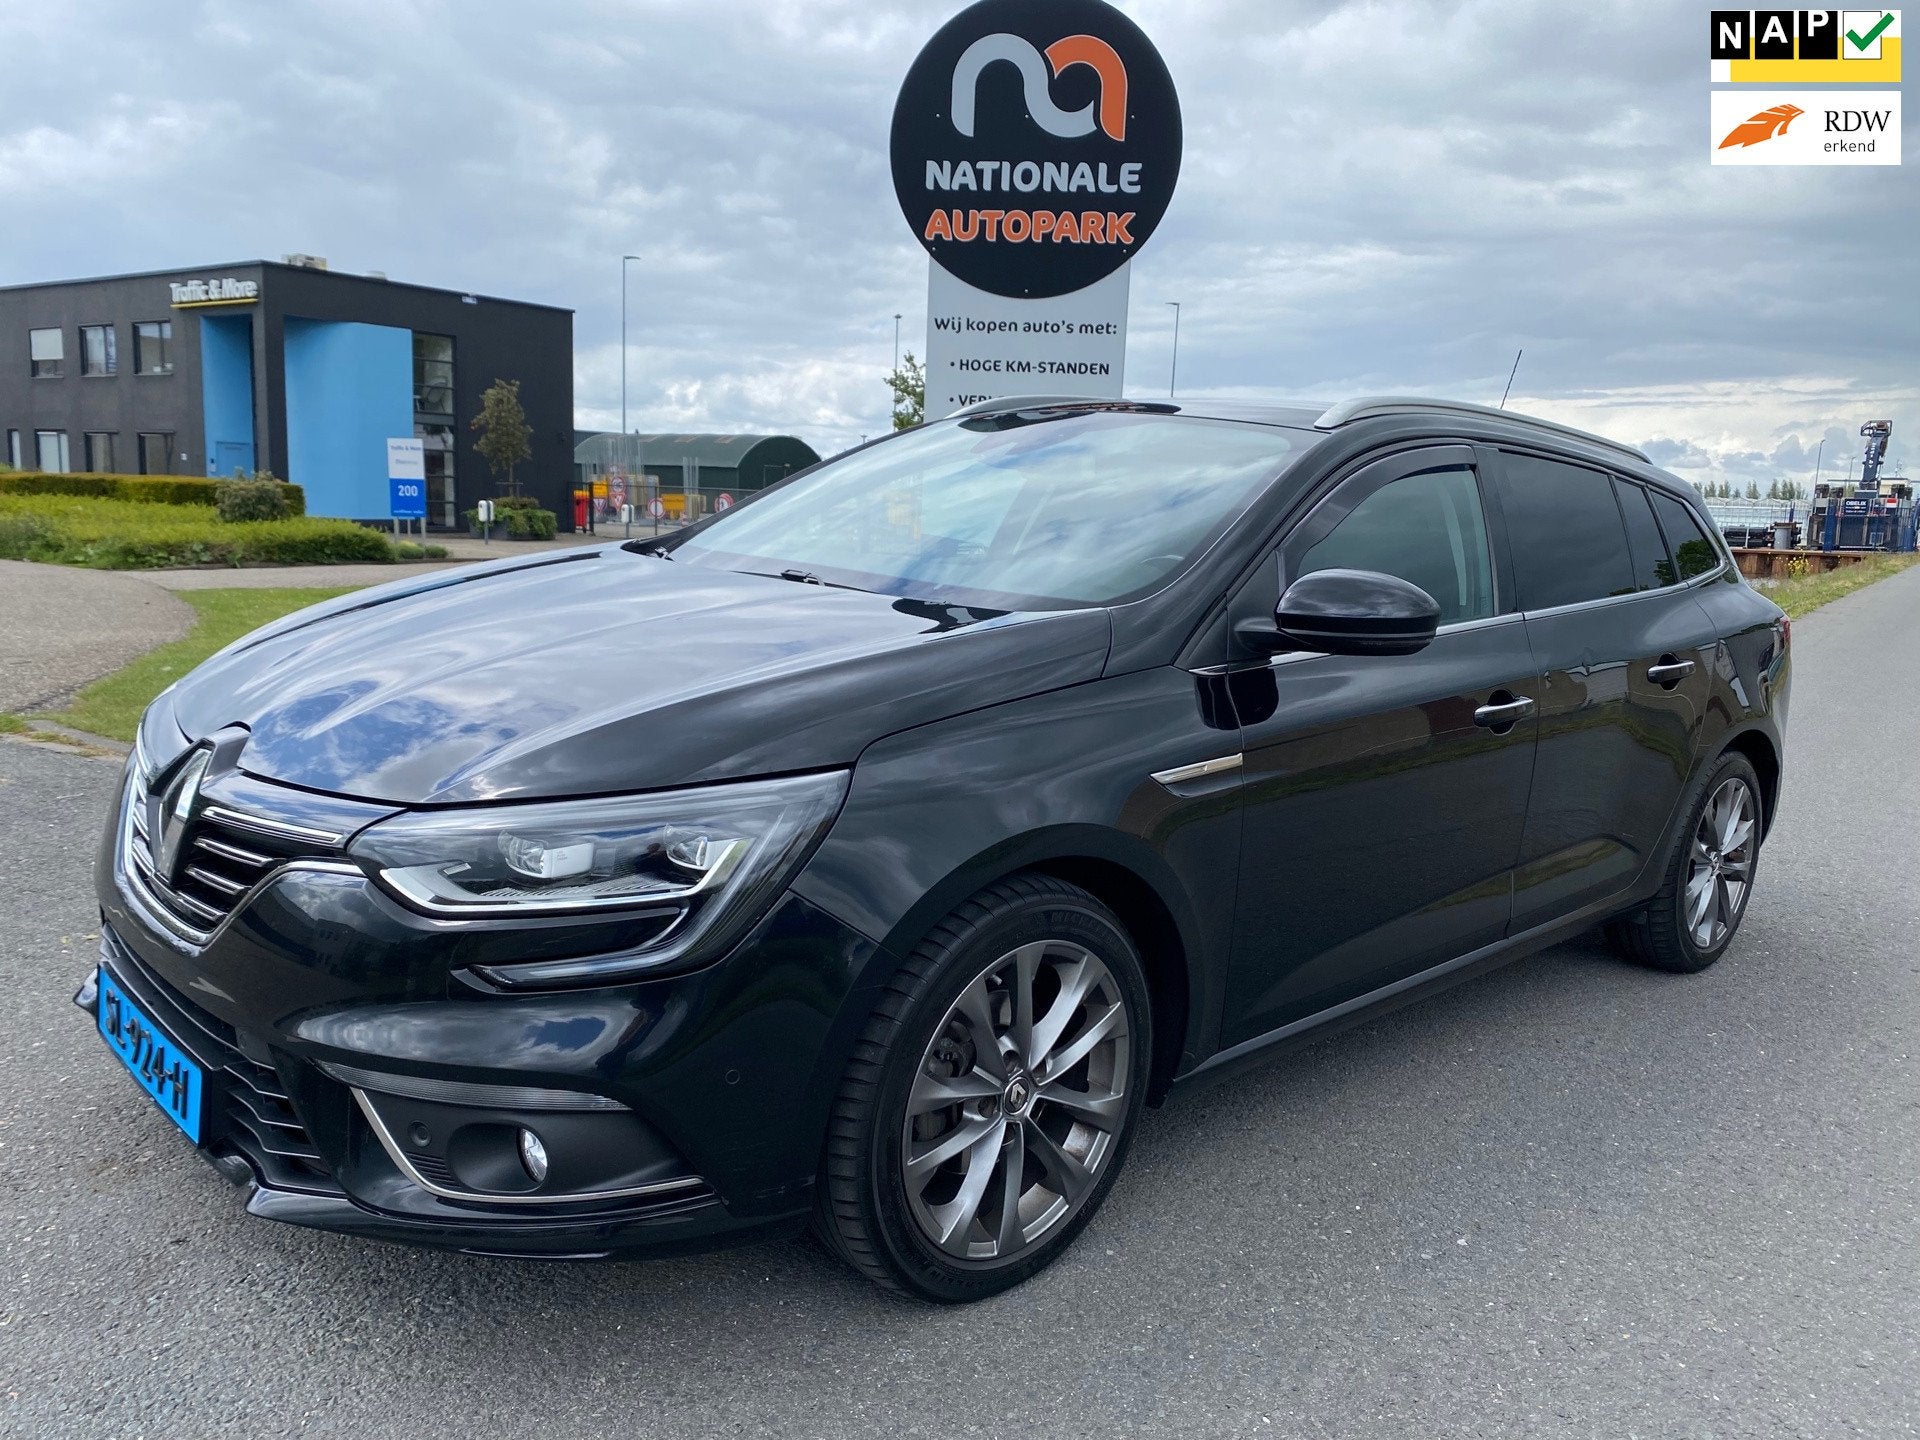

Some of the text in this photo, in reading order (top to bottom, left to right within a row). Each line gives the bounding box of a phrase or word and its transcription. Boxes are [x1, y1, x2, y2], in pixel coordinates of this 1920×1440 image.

[925, 160, 1143, 193] NATIONALE
[924, 209, 1136, 244] AUTOPARK
[169, 278, 258, 302] Traffic & More
[934, 318, 1118, 335] Wij kopen auto's met:
[959, 359, 1110, 375] HOGE KM-STANDEN
[398, 485, 418, 496] 200
